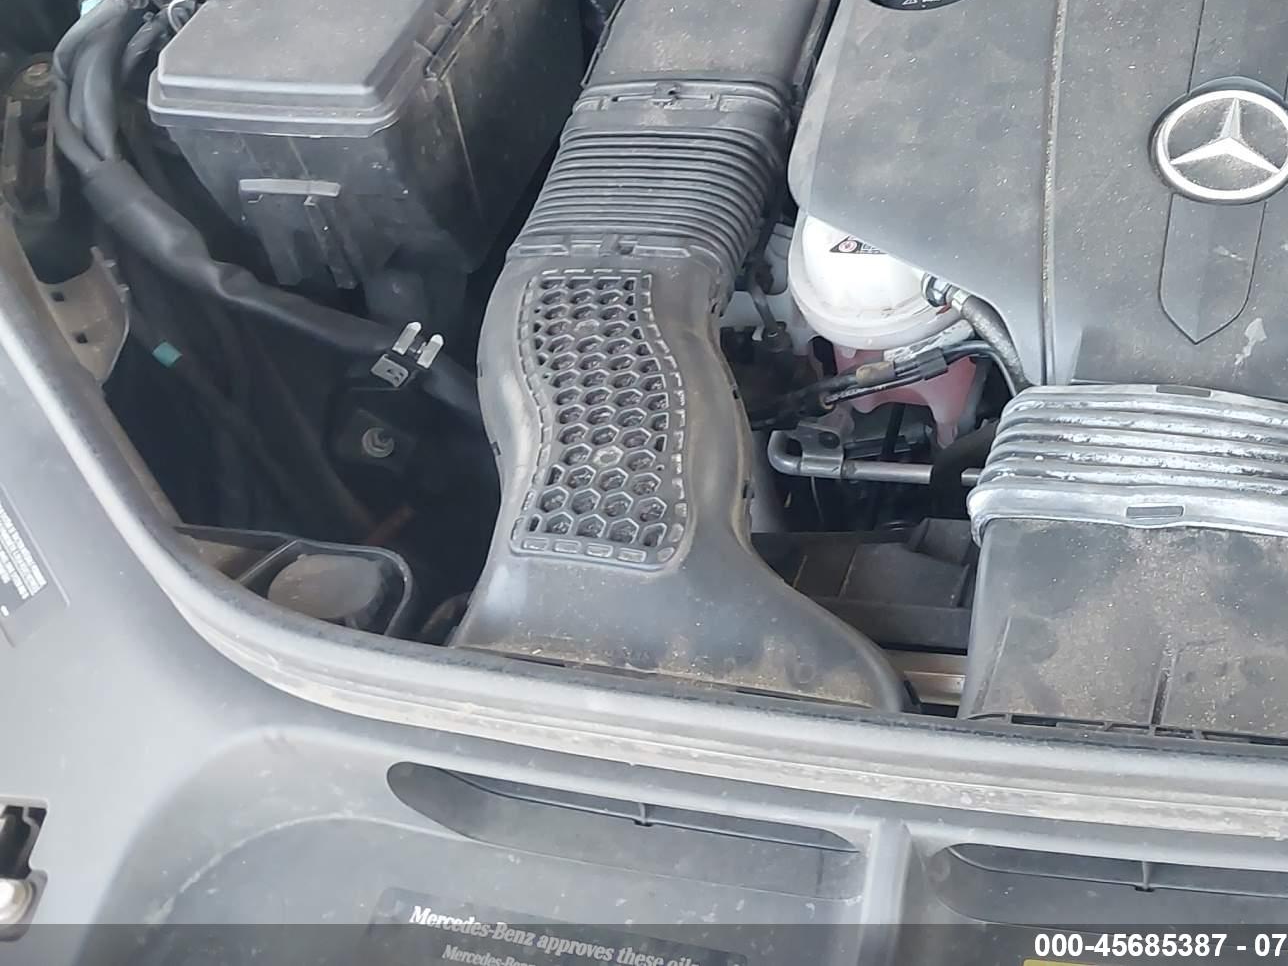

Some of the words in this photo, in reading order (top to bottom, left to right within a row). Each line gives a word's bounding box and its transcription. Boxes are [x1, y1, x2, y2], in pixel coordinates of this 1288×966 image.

[408, 905, 536, 946] Mercedes-Benz
[536, 934, 615, 962] approves
[616, 946, 664, 966] these
